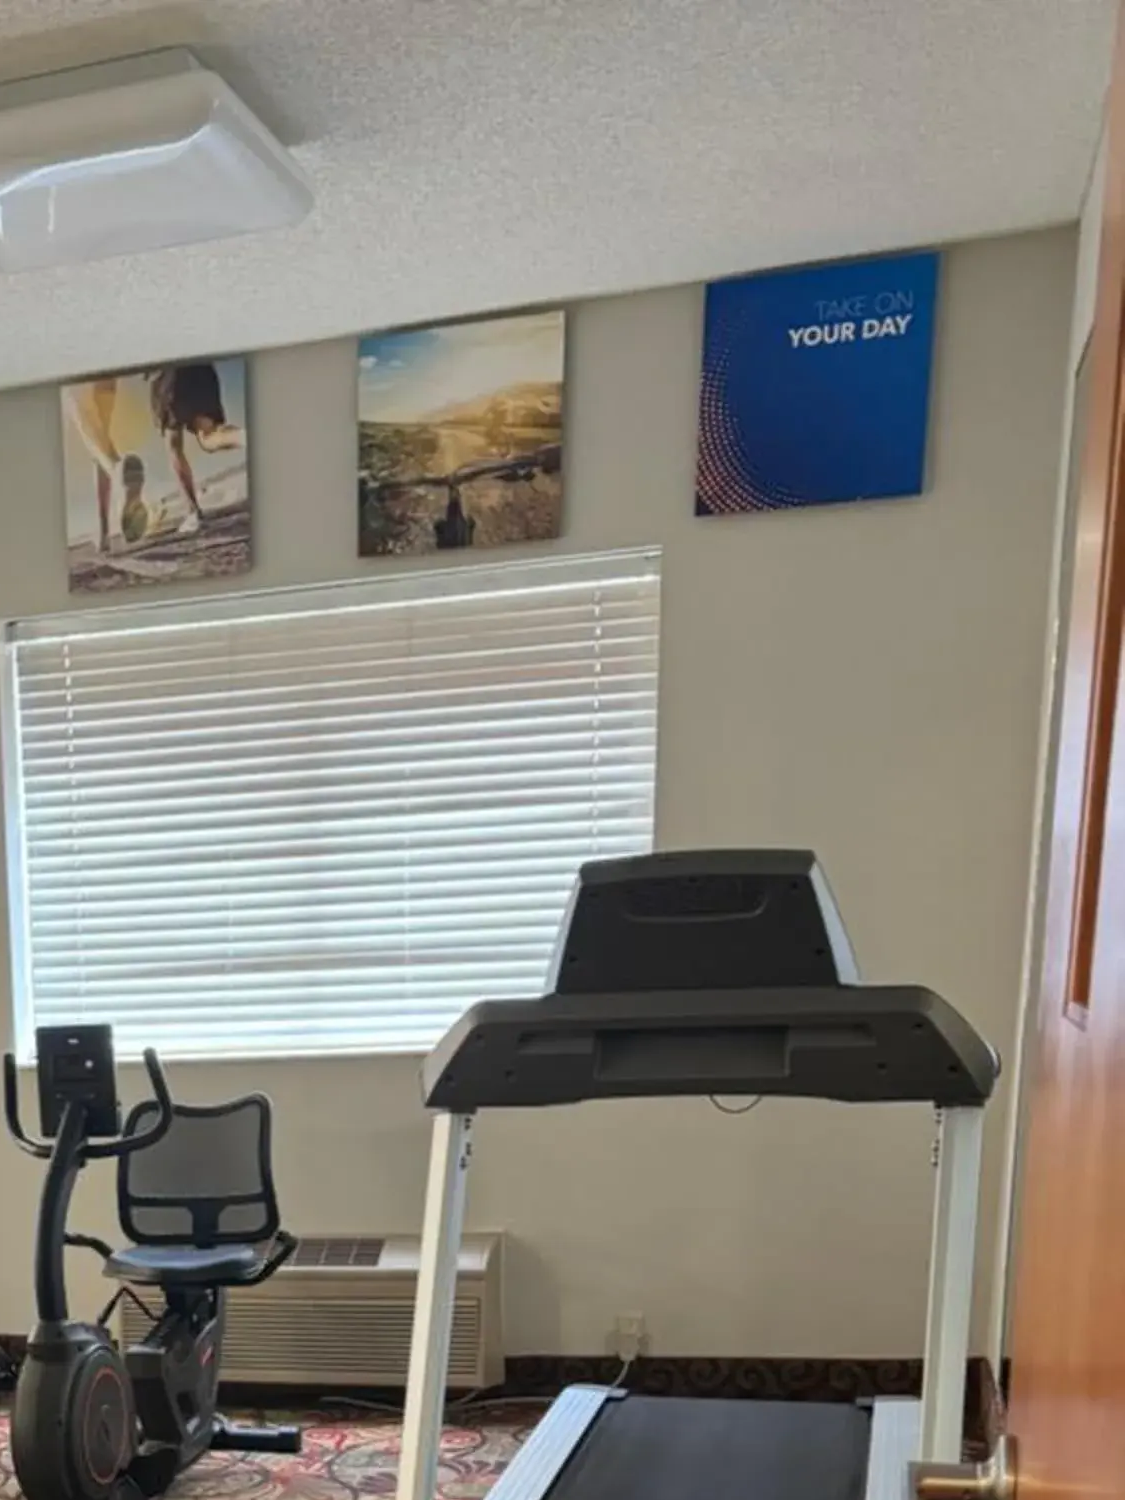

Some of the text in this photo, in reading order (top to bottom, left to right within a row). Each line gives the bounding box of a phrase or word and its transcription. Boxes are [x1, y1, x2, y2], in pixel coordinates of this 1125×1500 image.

[815, 290, 914, 321] TAKE ON
[788, 313, 913, 349] YOUR DAY
